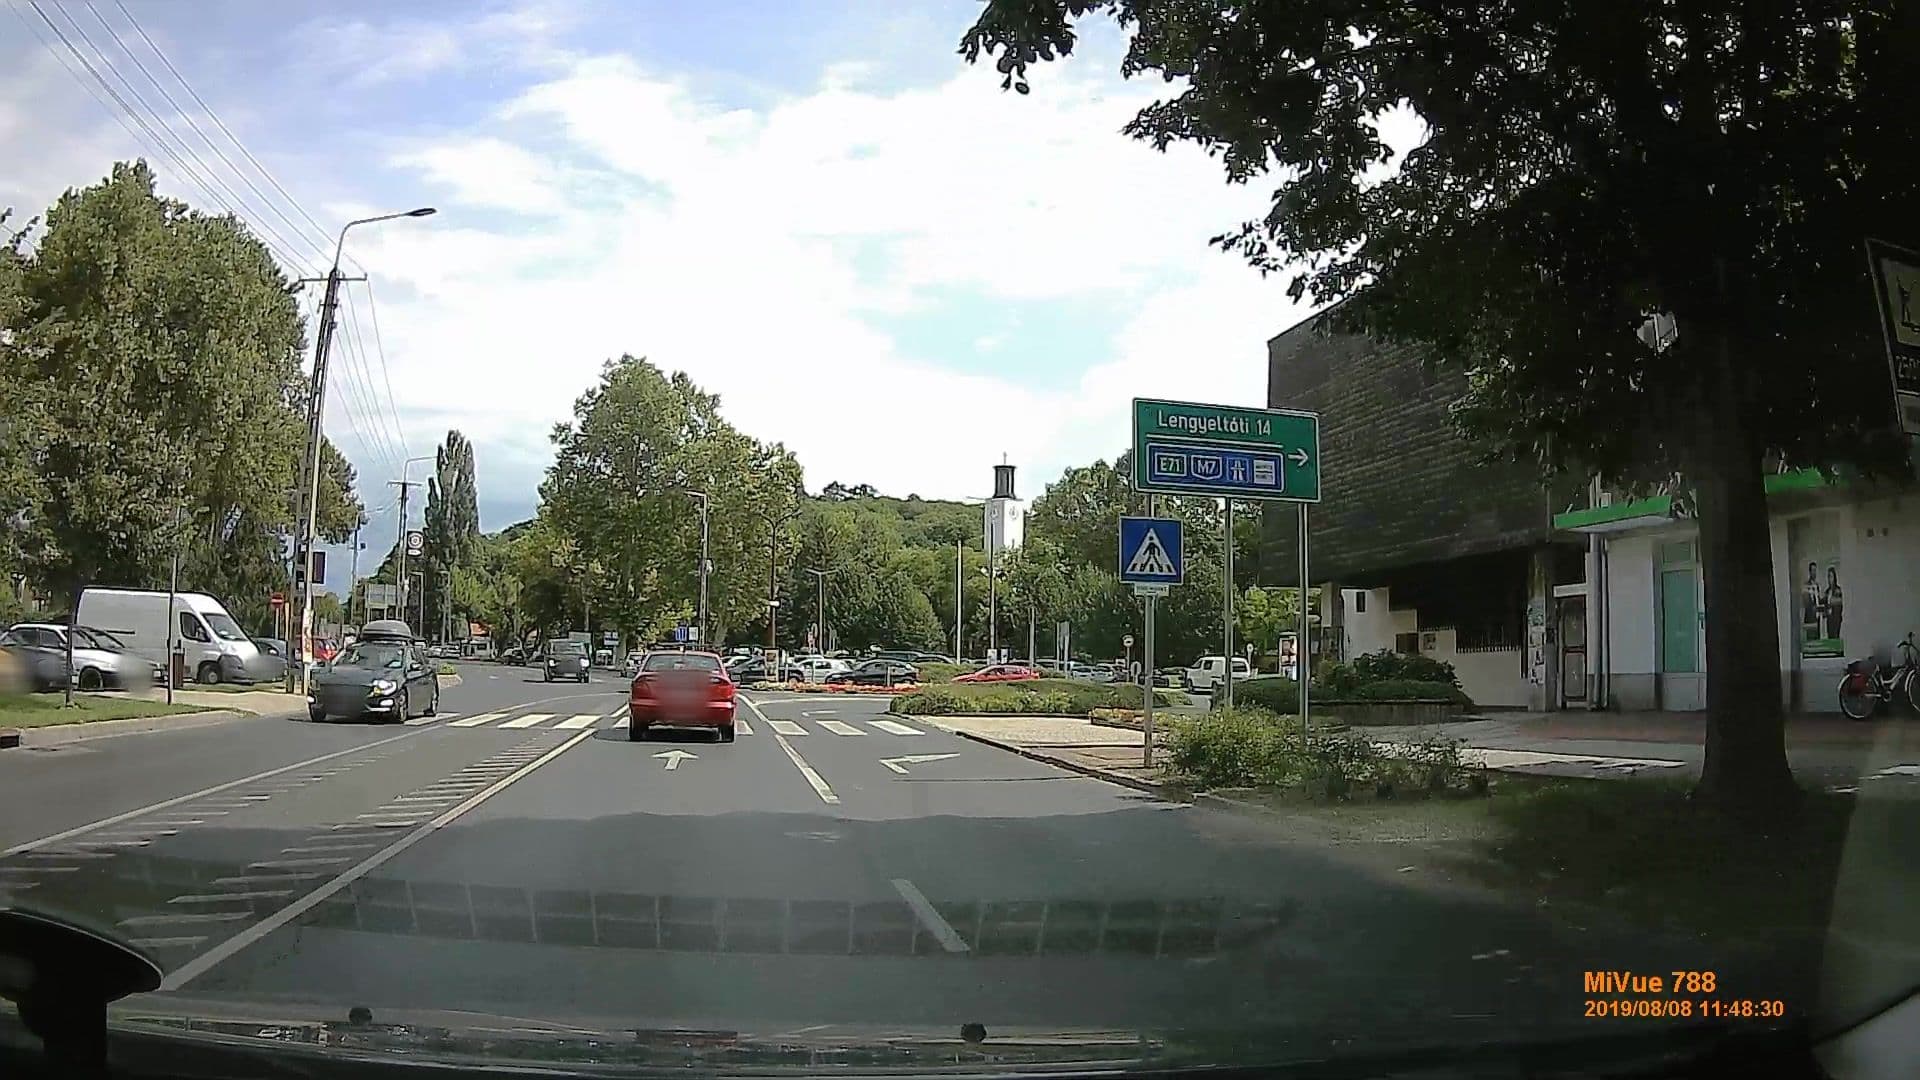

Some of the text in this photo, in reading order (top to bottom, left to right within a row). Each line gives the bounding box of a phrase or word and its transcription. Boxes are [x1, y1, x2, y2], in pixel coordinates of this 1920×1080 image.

[1157, 410, 1272, 436] Lengyeltóti 14
[1160, 456, 1182, 472] E71
[1197, 459, 1217, 475] M7
